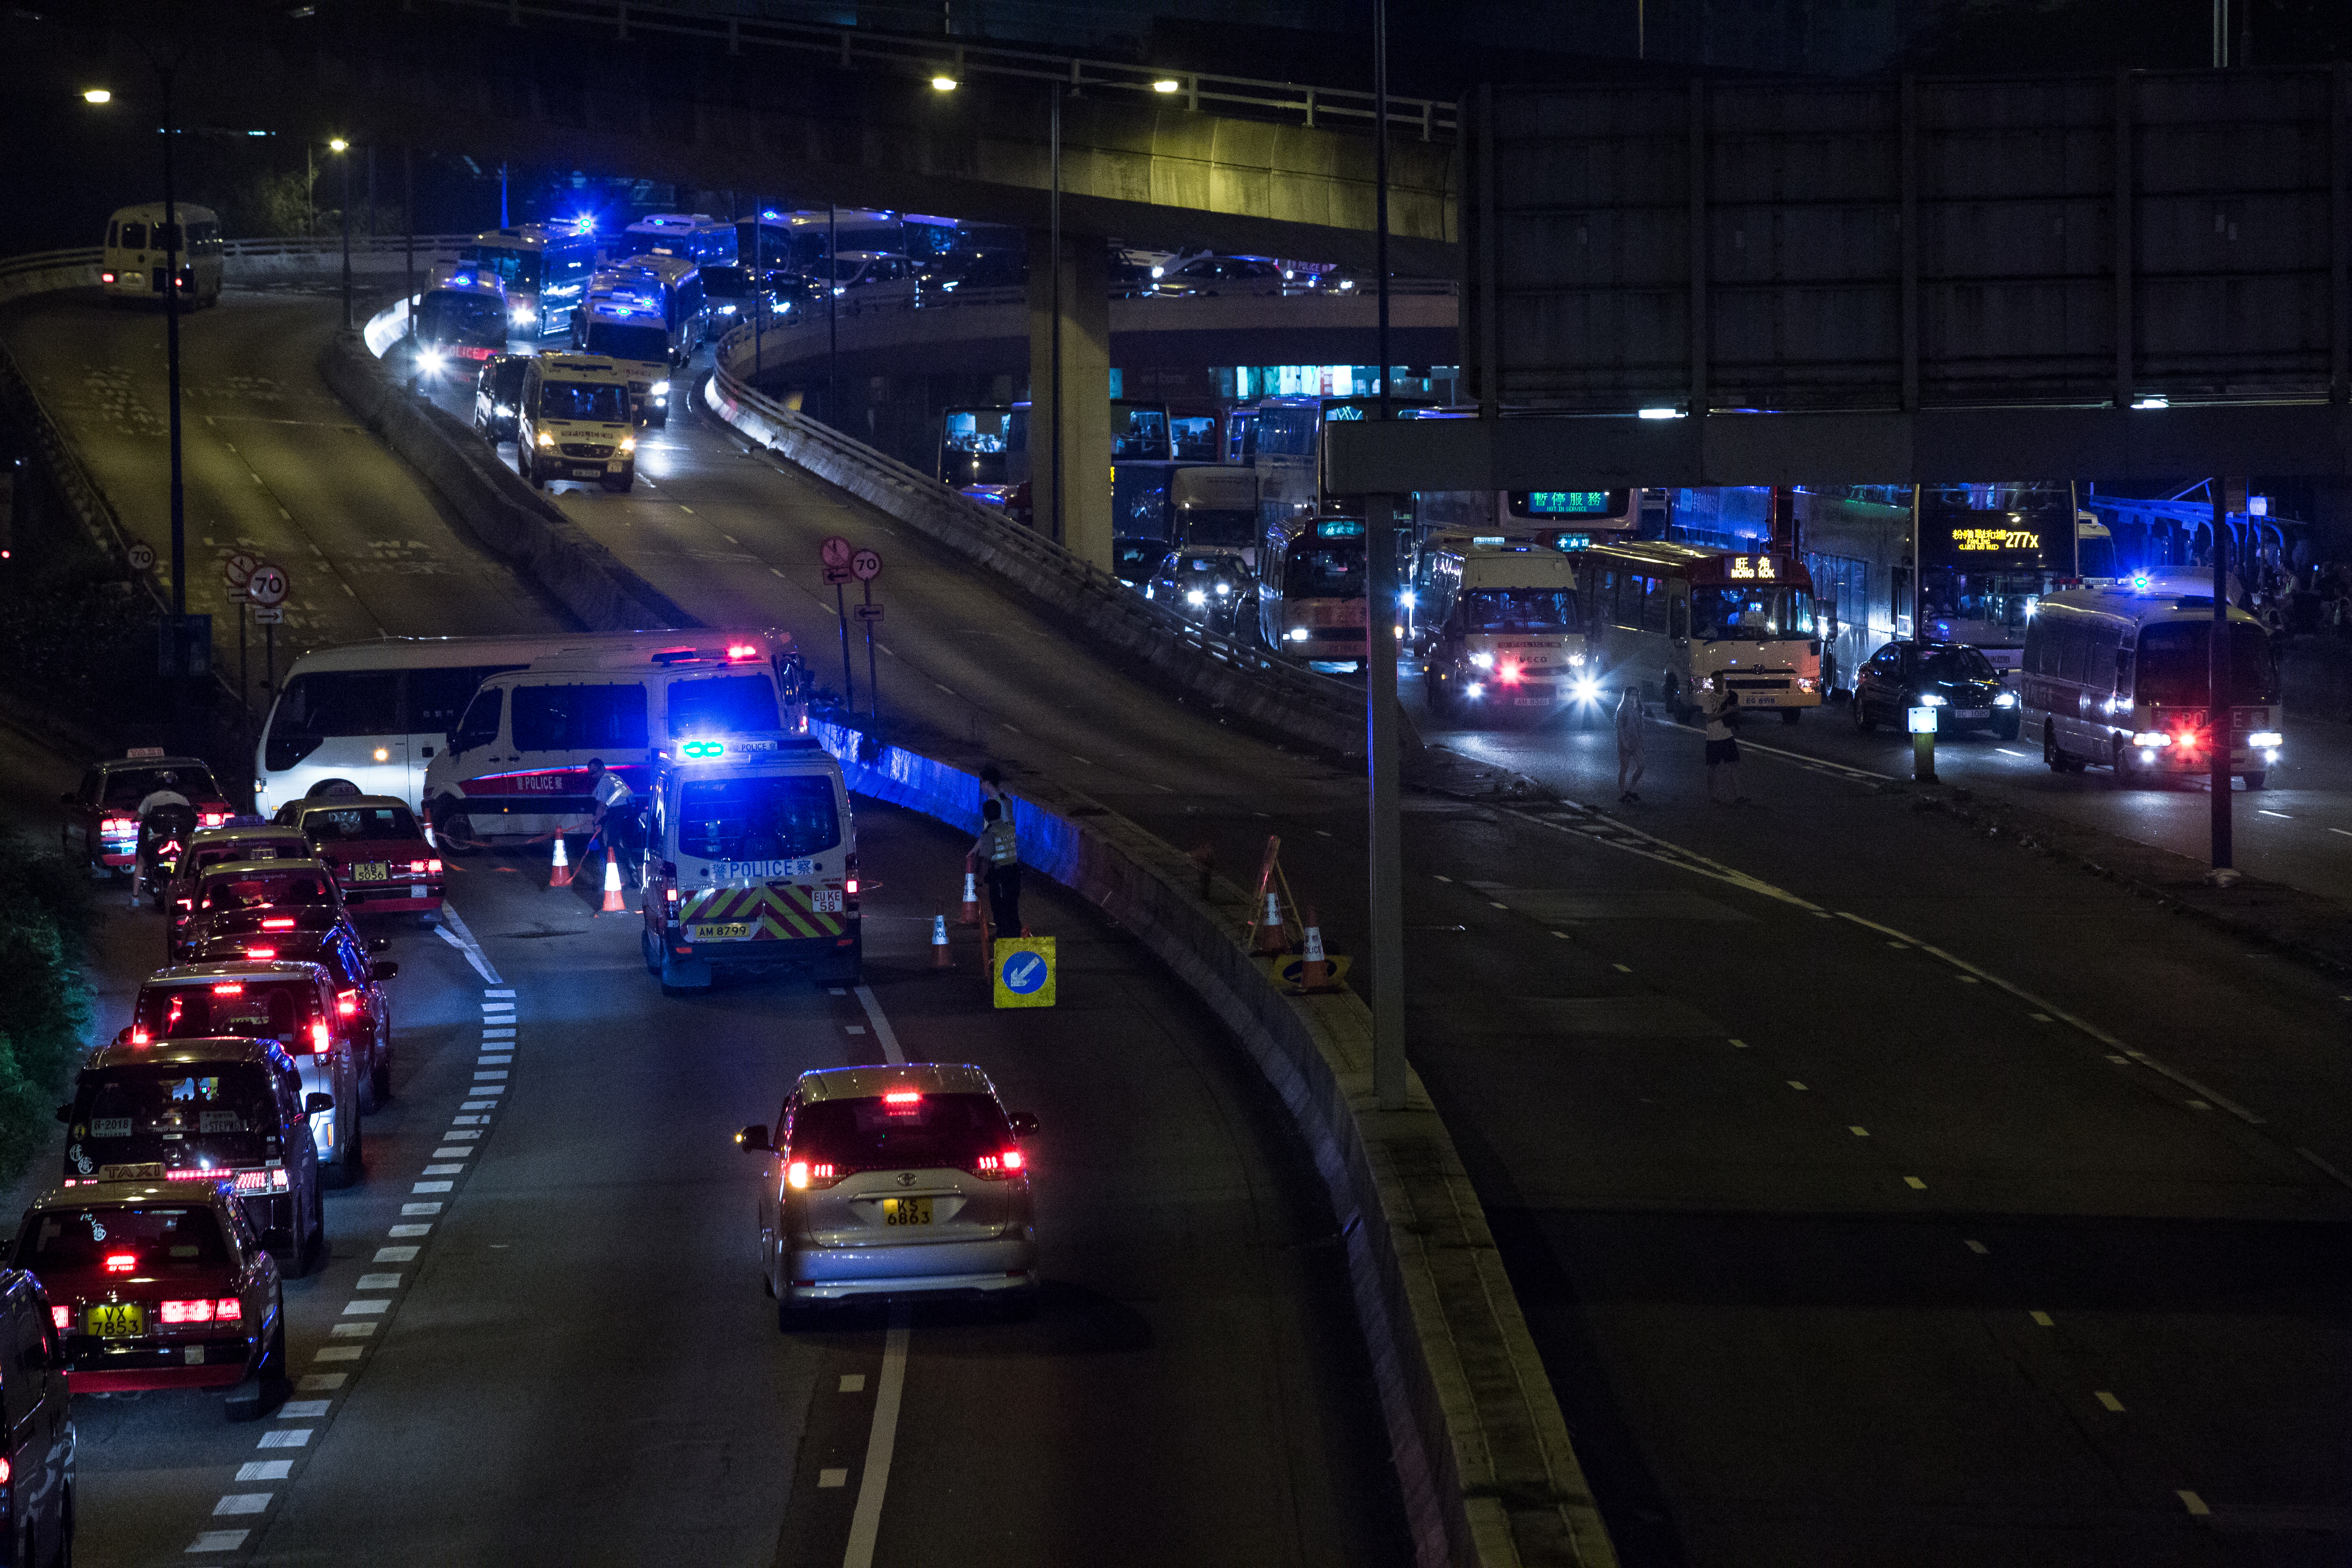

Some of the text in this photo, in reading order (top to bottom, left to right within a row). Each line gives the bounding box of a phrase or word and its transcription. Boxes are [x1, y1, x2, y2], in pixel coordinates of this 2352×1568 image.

[1534, 492, 1602, 506] 暫停服務
[132, 551, 151, 562] 70
[856, 559, 877, 571] 70
[1735, 557, 1771, 570] 旺角
[1731, 569, 1775, 579] MONG KOK
[255, 577, 282, 594] 70
[742, 743, 766, 751] POLICE
[525, 776, 553, 790] POLICE
[731, 860, 793, 878] POLICE
[797, 860, 811, 874] 察
[359, 872, 383, 881] 5056
[814, 891, 840, 902] EU KE
[820, 902, 835, 911] 58
[717, 926, 746, 935] 8799
[105, 1165, 160, 1178] TAXI
[898, 1200, 918, 1212] KS
[888, 1212, 930, 1225] 6863
[104, 1306, 125, 1320] VX
[93, 1319, 139, 1336] 7853
